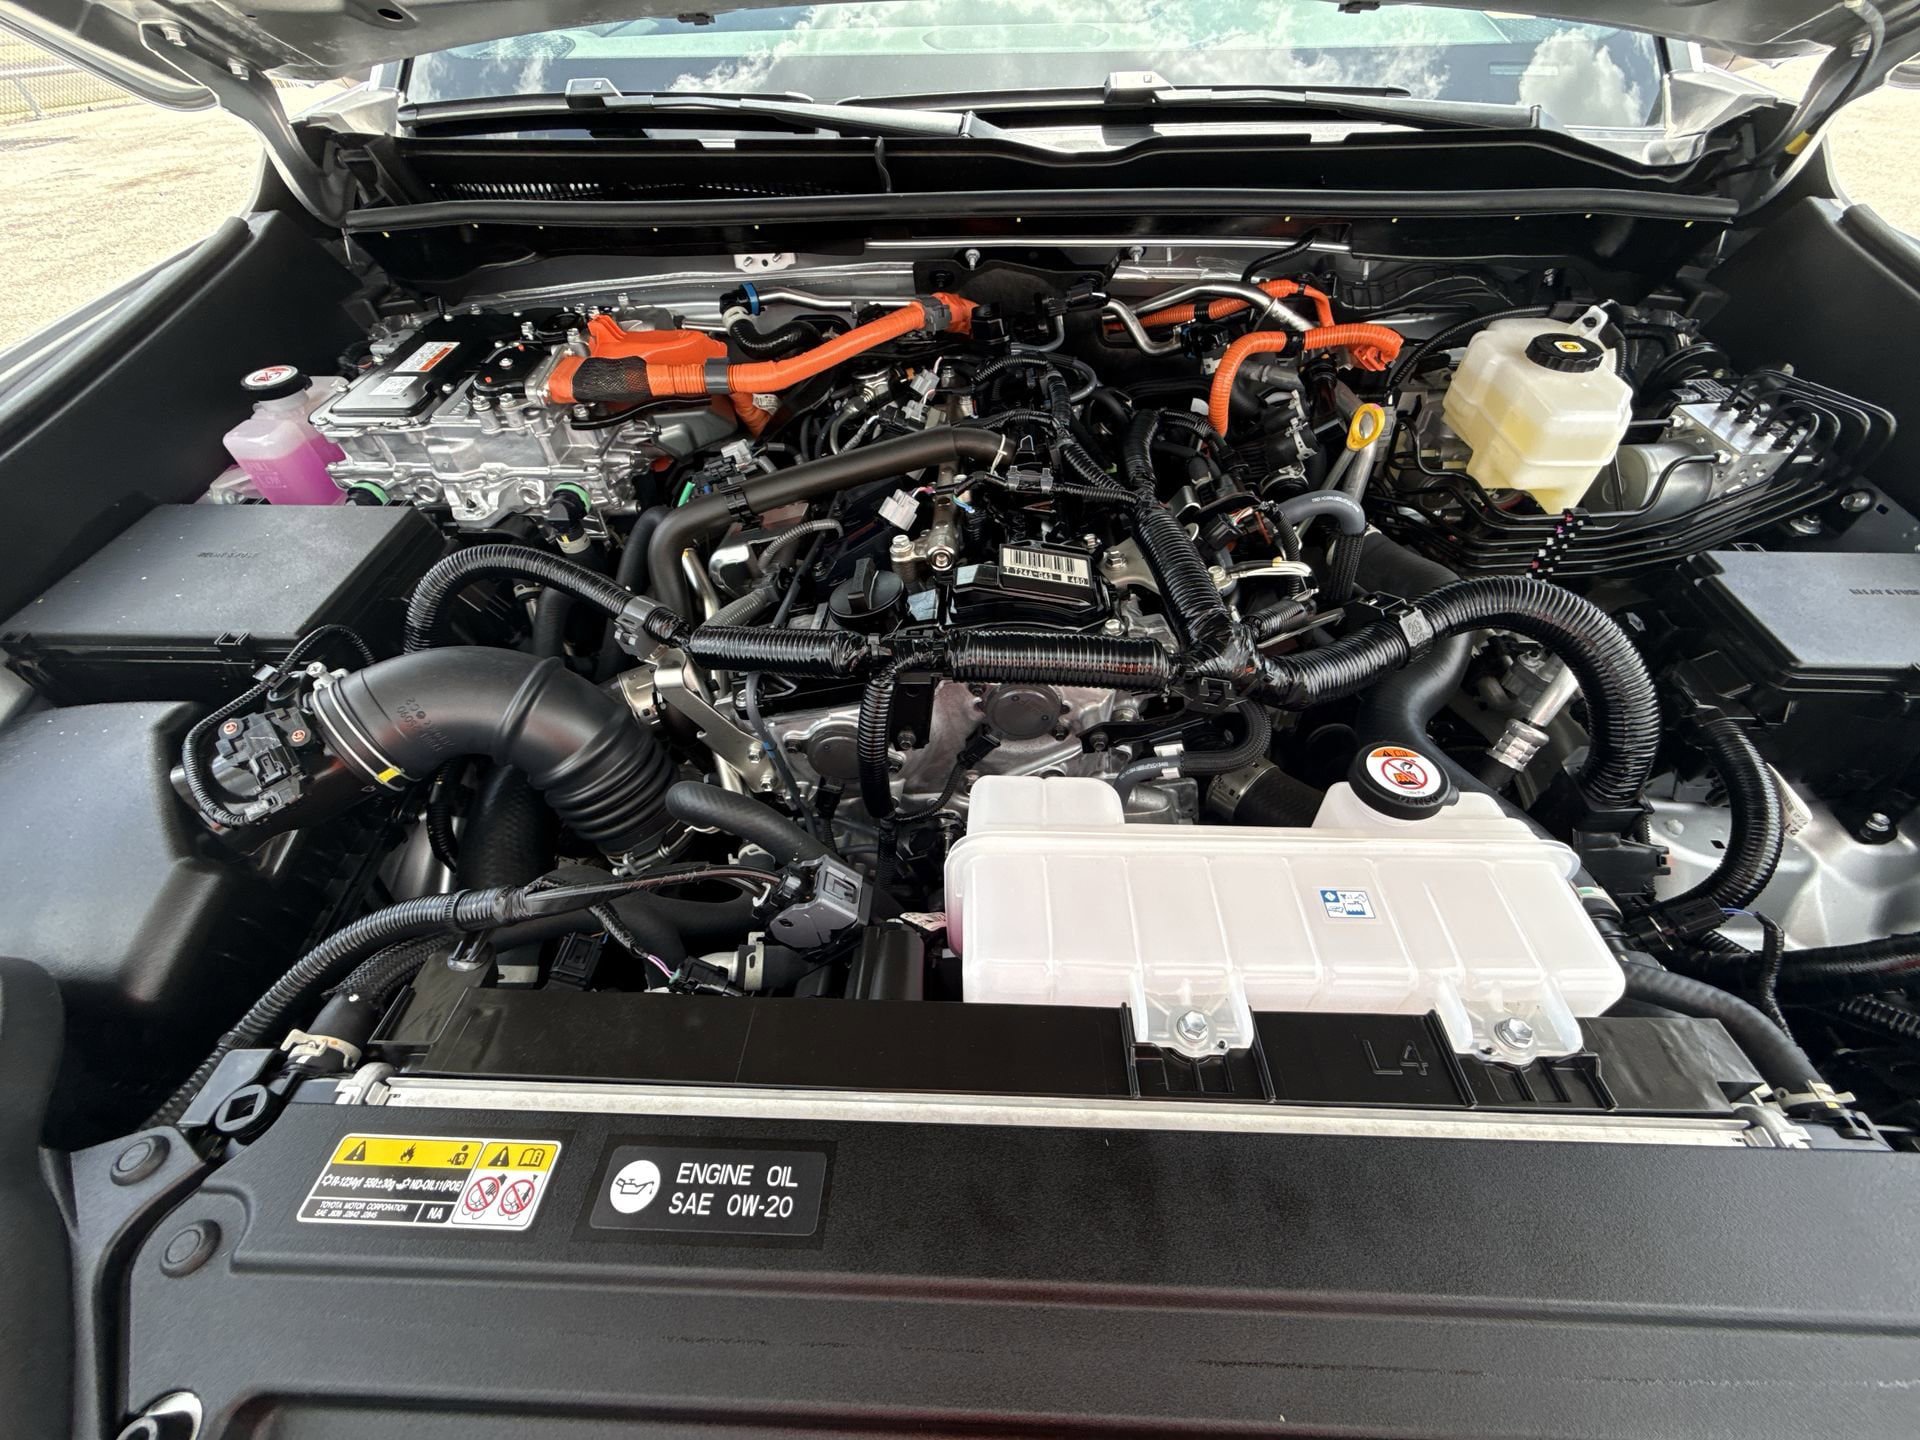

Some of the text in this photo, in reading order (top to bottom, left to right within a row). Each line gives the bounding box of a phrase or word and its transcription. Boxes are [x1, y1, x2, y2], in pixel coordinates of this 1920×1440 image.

[1362, 1040, 1429, 1075] L4
[675, 1162, 799, 1188] ENGINE OIL
[314, 1209, 328, 1217] SAE
[320, 1201, 408, 1212] TOYOTA MOTOR CORPORATION
[426, 1207, 444, 1219] NA
[668, 1192, 794, 1218] SAE 0W-20
